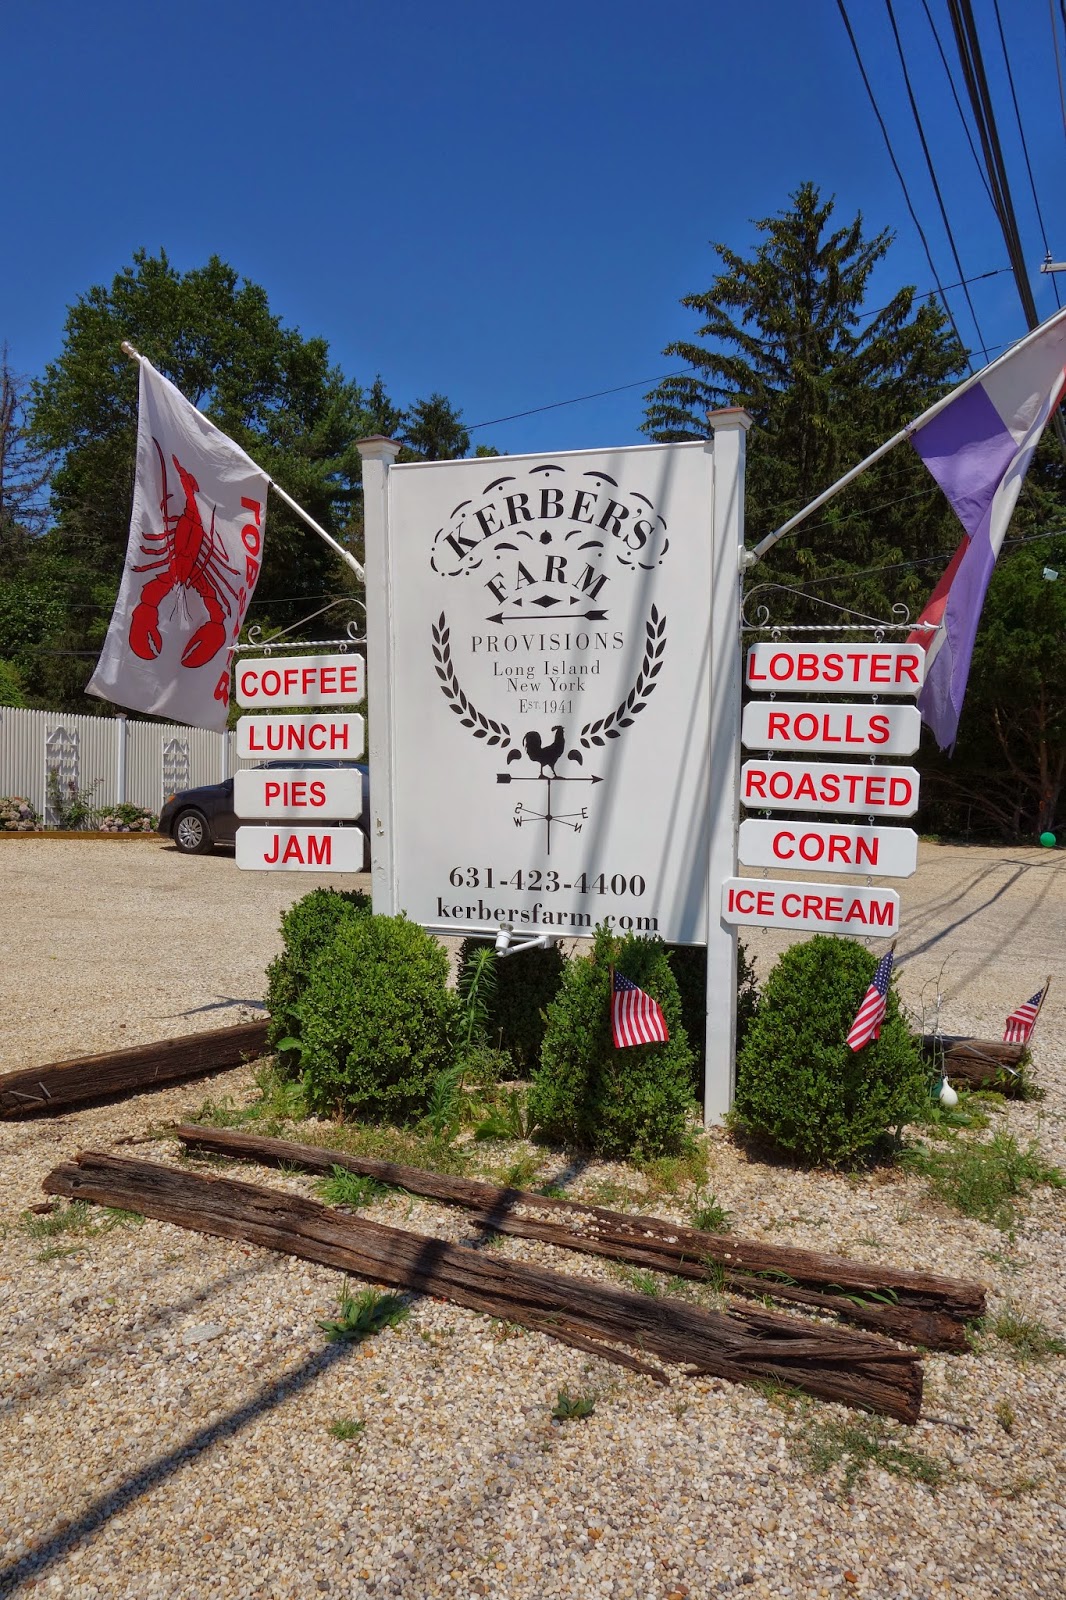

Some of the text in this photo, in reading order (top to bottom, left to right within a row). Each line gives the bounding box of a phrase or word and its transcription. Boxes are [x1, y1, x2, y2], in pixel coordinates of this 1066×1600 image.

[442, 488, 656, 562] KERBER'S
[483, 554, 611, 606] FARM
[471, 631, 624, 653] PROVISIONS
[240, 665, 358, 698] COFFEE
[493, 659, 601, 680] Long Island
[506, 676, 586, 692] New York
[749, 652, 920, 684] LOBSTER
[542, 699, 573, 714] 1941
[248, 723, 349, 751] LUNCH
[767, 711, 891, 745] ROLLS
[264, 780, 327, 808] PIES
[745, 769, 913, 807] ROASTED
[263, 834, 332, 865] JAM
[772, 831, 880, 866] CORN
[449, 866, 646, 897] 631-423-4400
[436, 897, 660, 931] kerbersfarm.com
[727, 888, 895, 927] ICE CREAM
